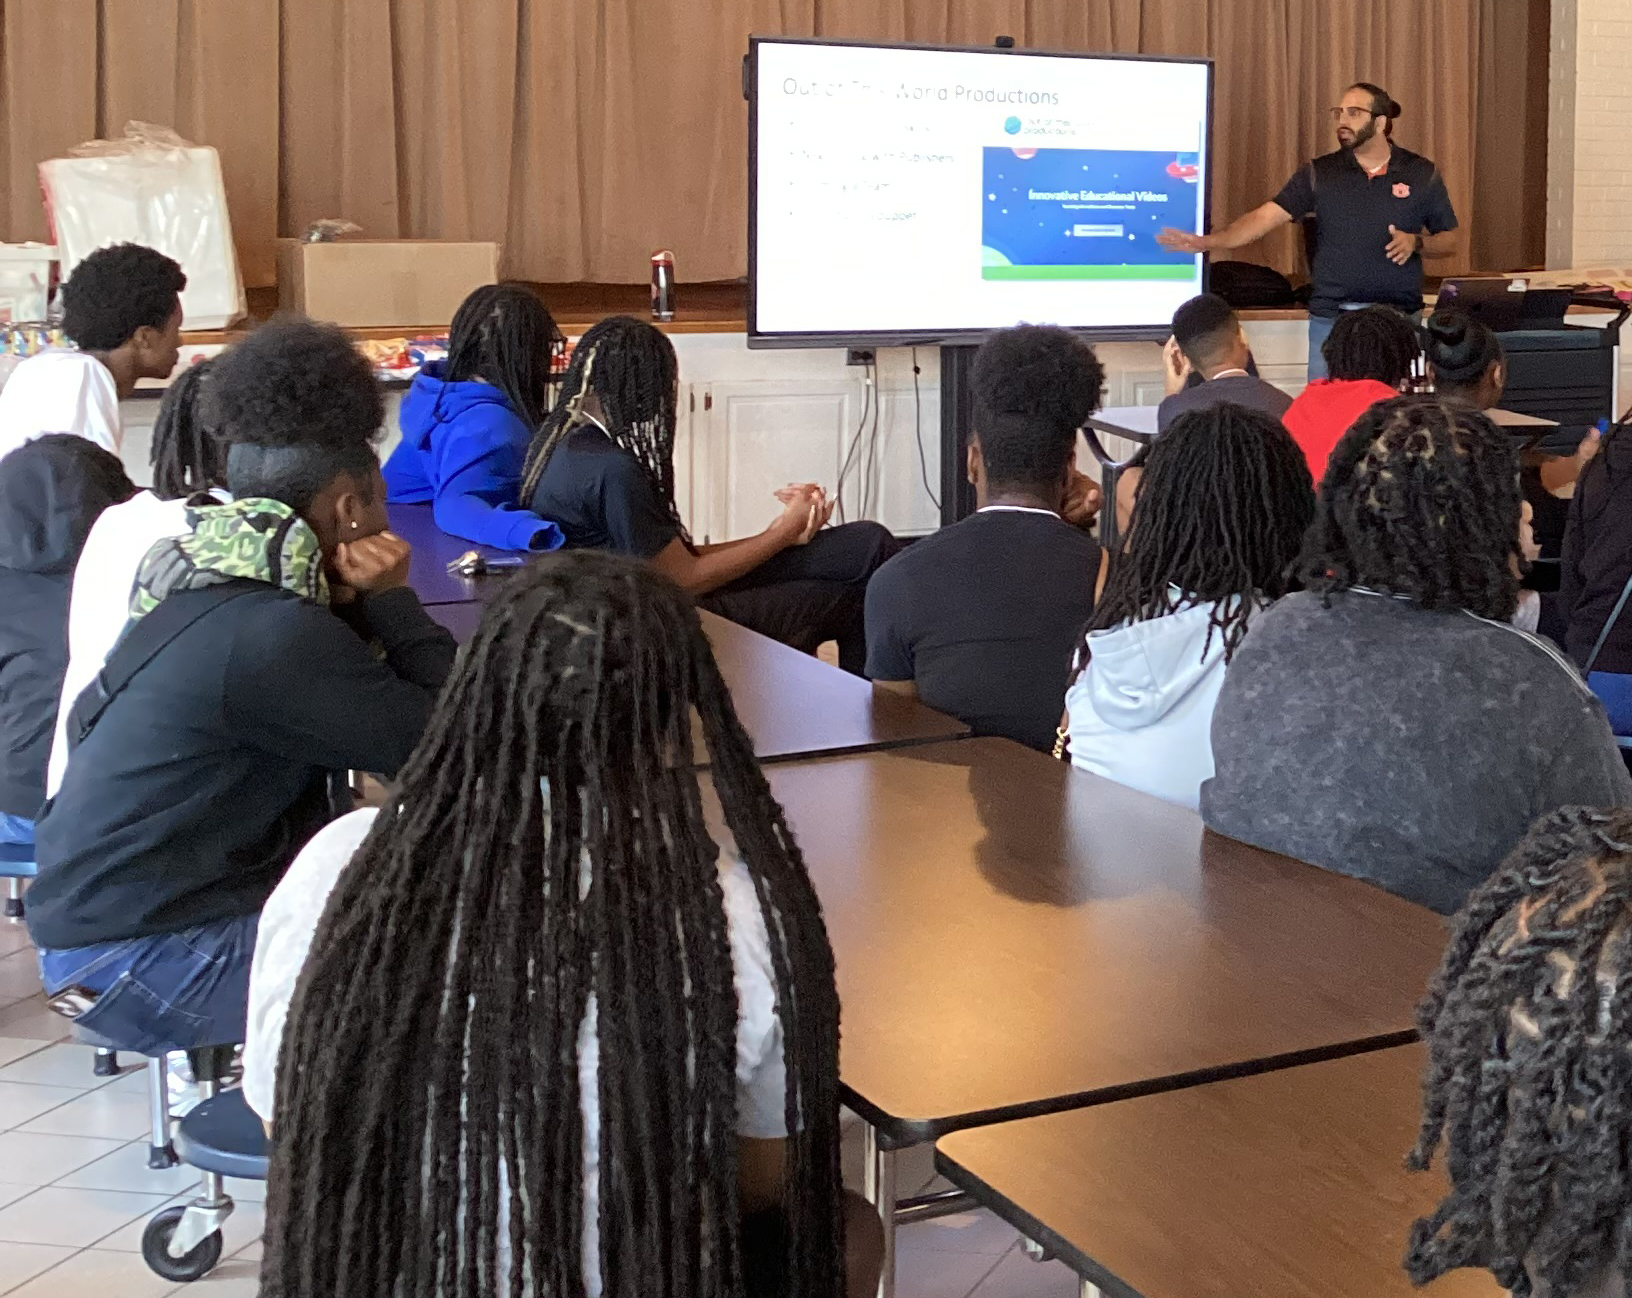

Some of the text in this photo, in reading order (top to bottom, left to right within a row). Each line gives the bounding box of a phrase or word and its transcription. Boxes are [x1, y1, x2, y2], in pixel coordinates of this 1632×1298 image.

[955, 84, 1059, 106] Productions
[1080, 190, 1135, 202] Educational
[1135, 190, 1168, 202] Videos
